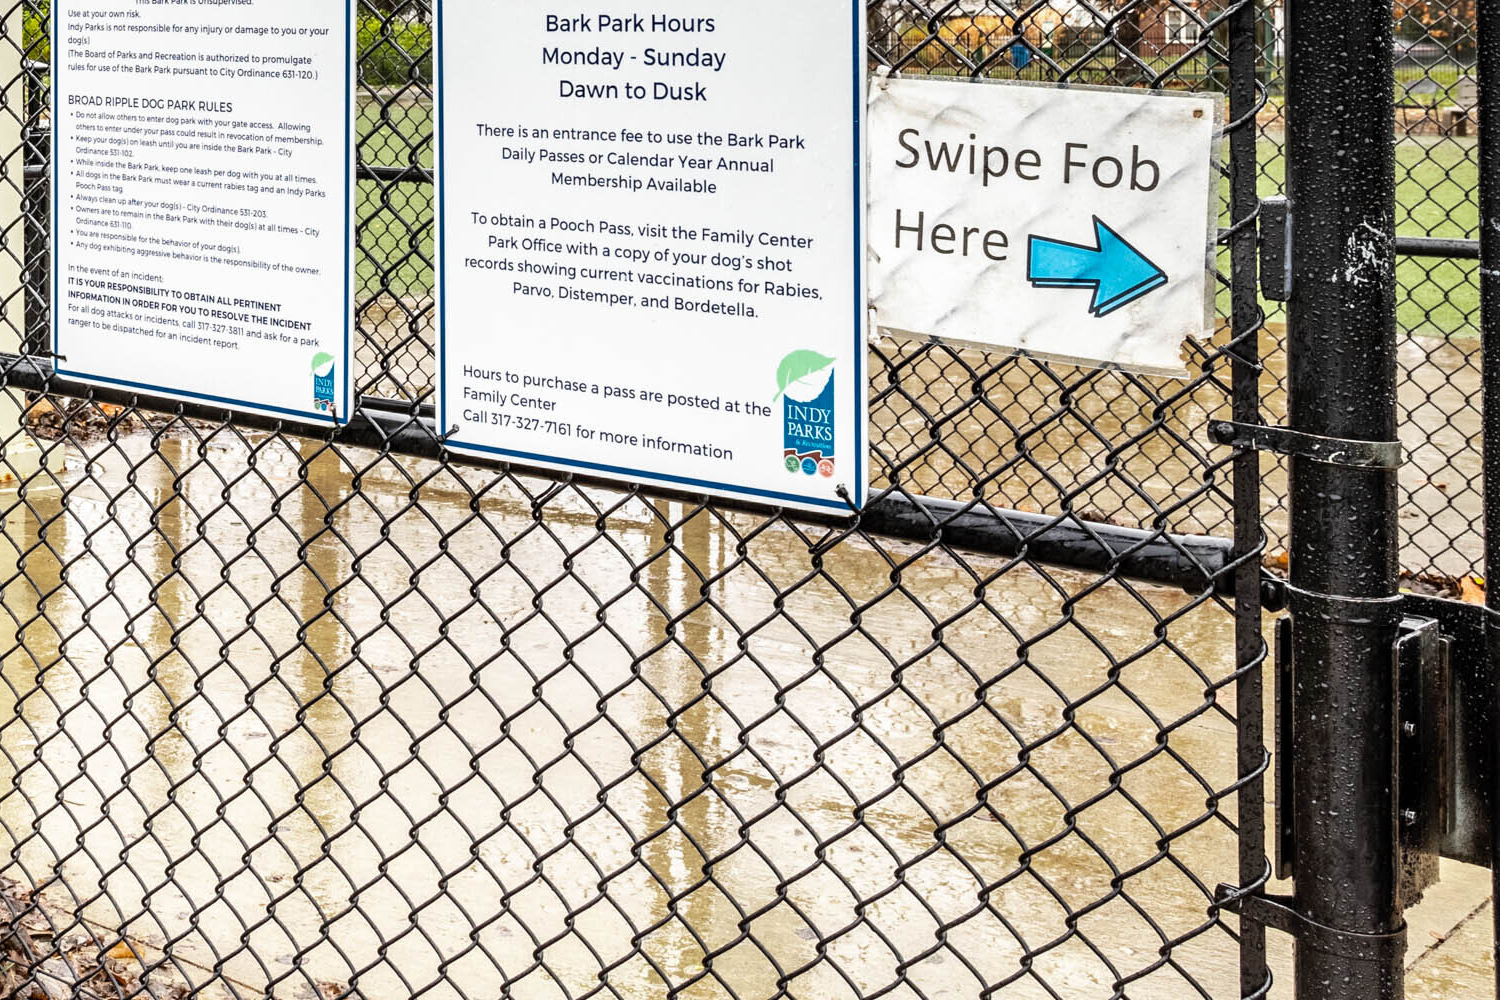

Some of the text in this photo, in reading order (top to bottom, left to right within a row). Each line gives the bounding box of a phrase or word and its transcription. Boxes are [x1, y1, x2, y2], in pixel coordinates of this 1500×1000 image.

[67, 22, 83, 32] Indy
[84, 22, 105, 31] Parks
[105, 22, 112, 31] is
[112, 23, 126, 31] not
[126, 23, 170, 33] responsible
[171, 23, 183, 32] for
[184, 25, 199, 35] any
[200, 23, 223, 35] injury
[234, 24, 269, 36] damage
[270, 26, 279, 34] to
[280, 27, 296, 36] you
[298, 27, 307, 35] or
[309, 27, 329, 37] your
[545, 13, 715, 32] Bark Park Hours
[542, 46, 624, 69] Monday
[643, 47, 726, 71] Sunday
[68, 94, 232, 112] BROAD RIPPLE DOG PARK RULES
[559, 79, 707, 101] Dawn to Dusk
[475, 122, 805, 149] There is an entrance fee to use the Bark Park
[501, 146, 773, 173] Daily Passes or Calendar Year Annual
[895, 127, 1161, 192] Swipe Fob
[551, 171, 716, 194] Membership Available
[470, 211, 814, 249] To obtain a Pooch Pass, visit the Family Center
[895, 208, 1010, 261] Here
[488, 234, 792, 272] Park Office with a copy of your dog's shot
[464, 257, 822, 300] records showing current vaccinations for Rabies,
[68, 276, 282, 312] IT IS YOUR RESPONSIBILITY TO OBTAIN ALL PERTINENT
[512, 281, 758, 318] Parvo, Distemper, and Bordetella.
[67, 289, 312, 331] INFORMATION IN ORDER FOR YOU TO RESOLVE THE INCIDENT
[463, 363, 771, 417] Hours to purchase a pass are posted at the
[463, 386, 556, 411] Family Center
[787, 404, 832, 425] INDY
[463, 408, 732, 460] Call 317-327-7161 for more information
[787, 421, 833, 441] PARKS
